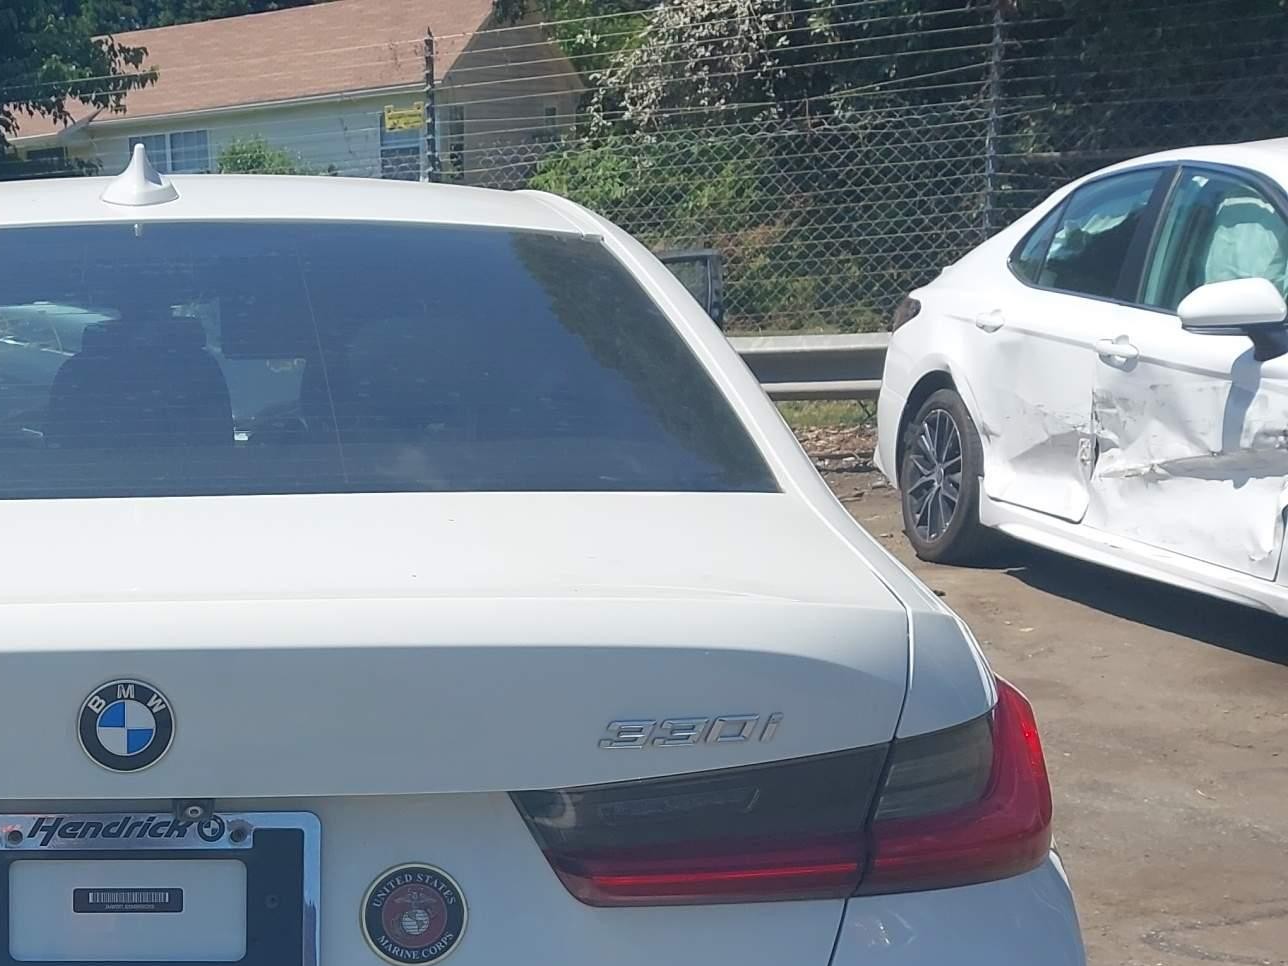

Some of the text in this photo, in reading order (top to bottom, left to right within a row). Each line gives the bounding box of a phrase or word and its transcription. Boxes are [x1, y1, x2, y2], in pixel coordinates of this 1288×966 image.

[88, 684, 166, 714] BMW
[598, 712, 784, 749] 330i
[27, 817, 194, 846] Hendrick
[373, 873, 456, 908] UNITED STATES
[377, 931, 454, 960] MARINE CORPS
